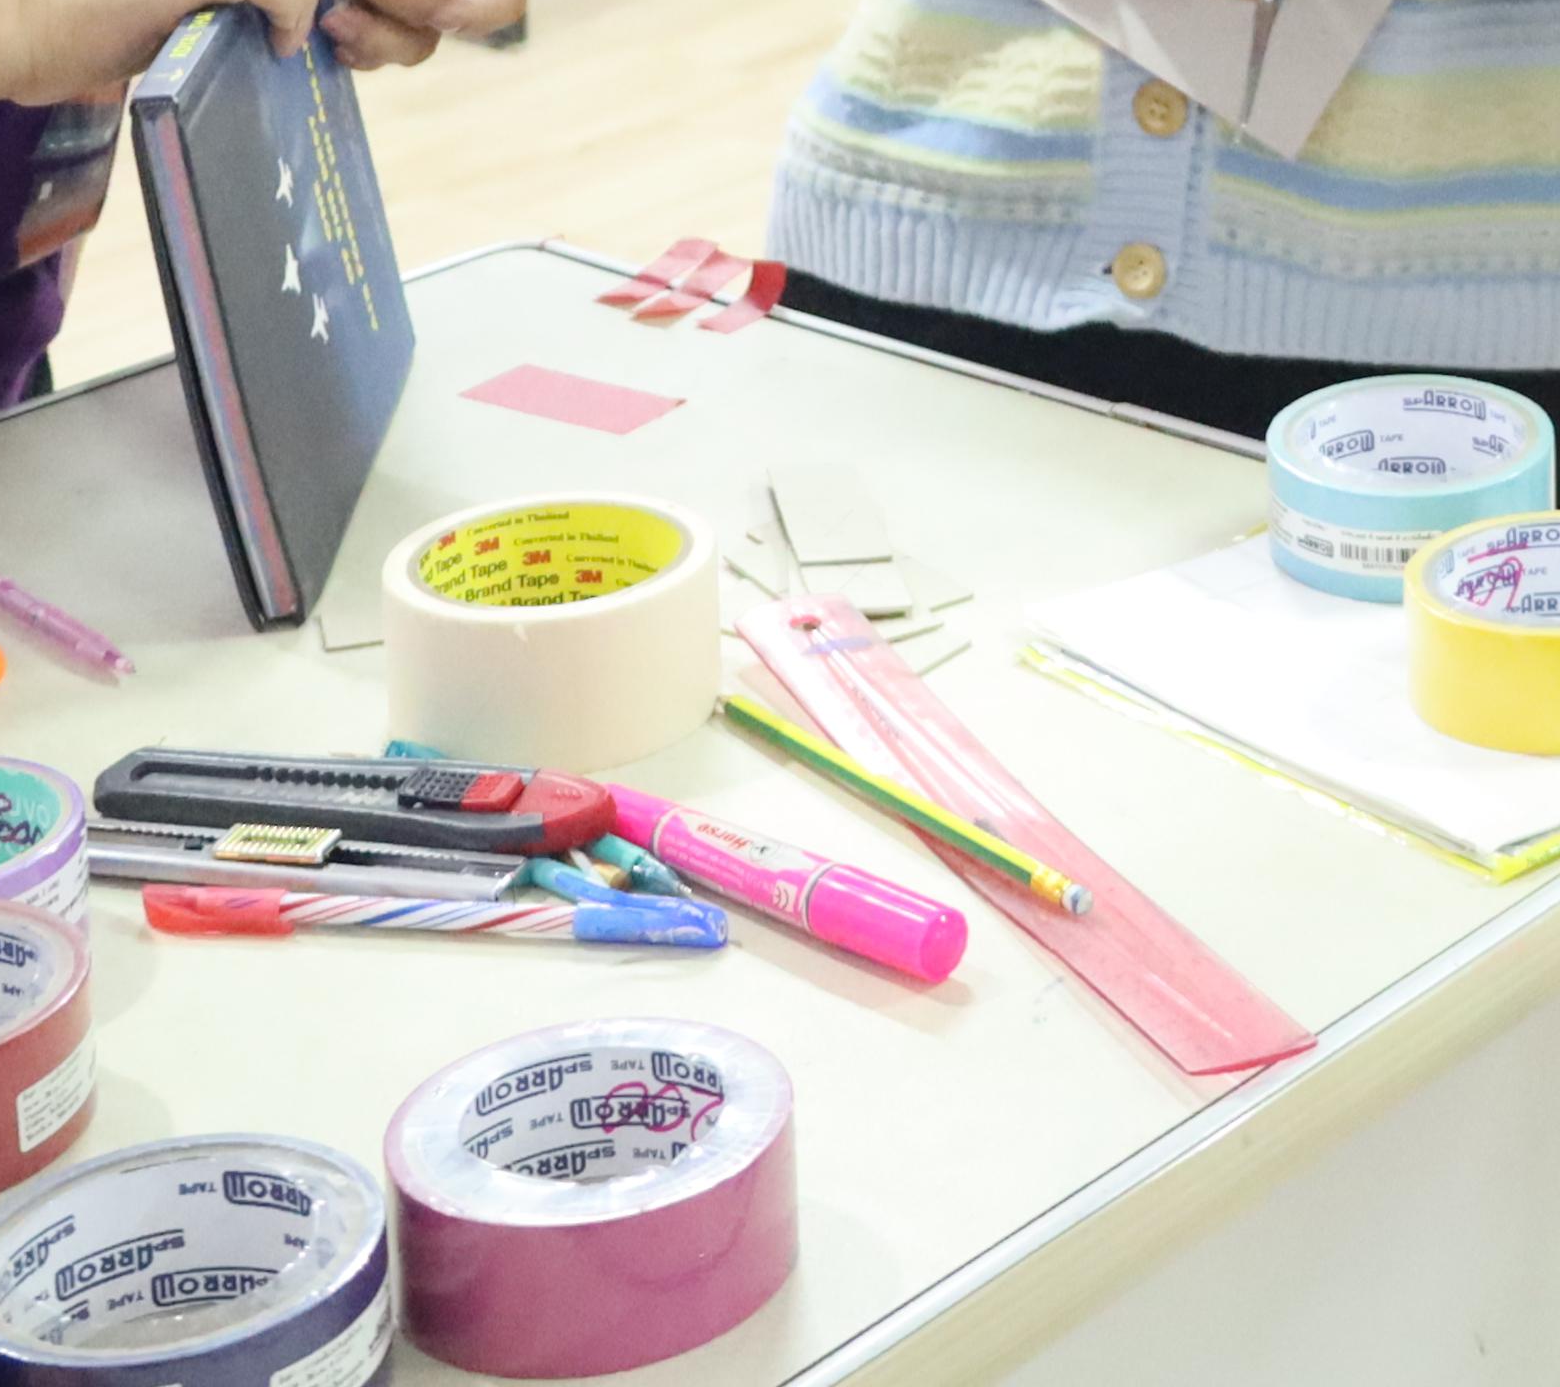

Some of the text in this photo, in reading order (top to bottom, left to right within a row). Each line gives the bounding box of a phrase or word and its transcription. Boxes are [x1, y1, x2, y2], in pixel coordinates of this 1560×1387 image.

[474, 537, 500, 556] 3M
[470, 559, 508, 579] Tape
[522, 550, 551, 567] 3M
[465, 576, 512, 603] Brand
[516, 572, 560, 588] Tape
[575, 570, 603, 585] 3M
[697, 823, 752, 850] Horse
[611, 1060, 645, 1071] TAPE
[476, 1053, 593, 1116] SPARROW
[178, 1182, 217, 1196] TAPE
[56, 1230, 184, 1301] SPARROW
